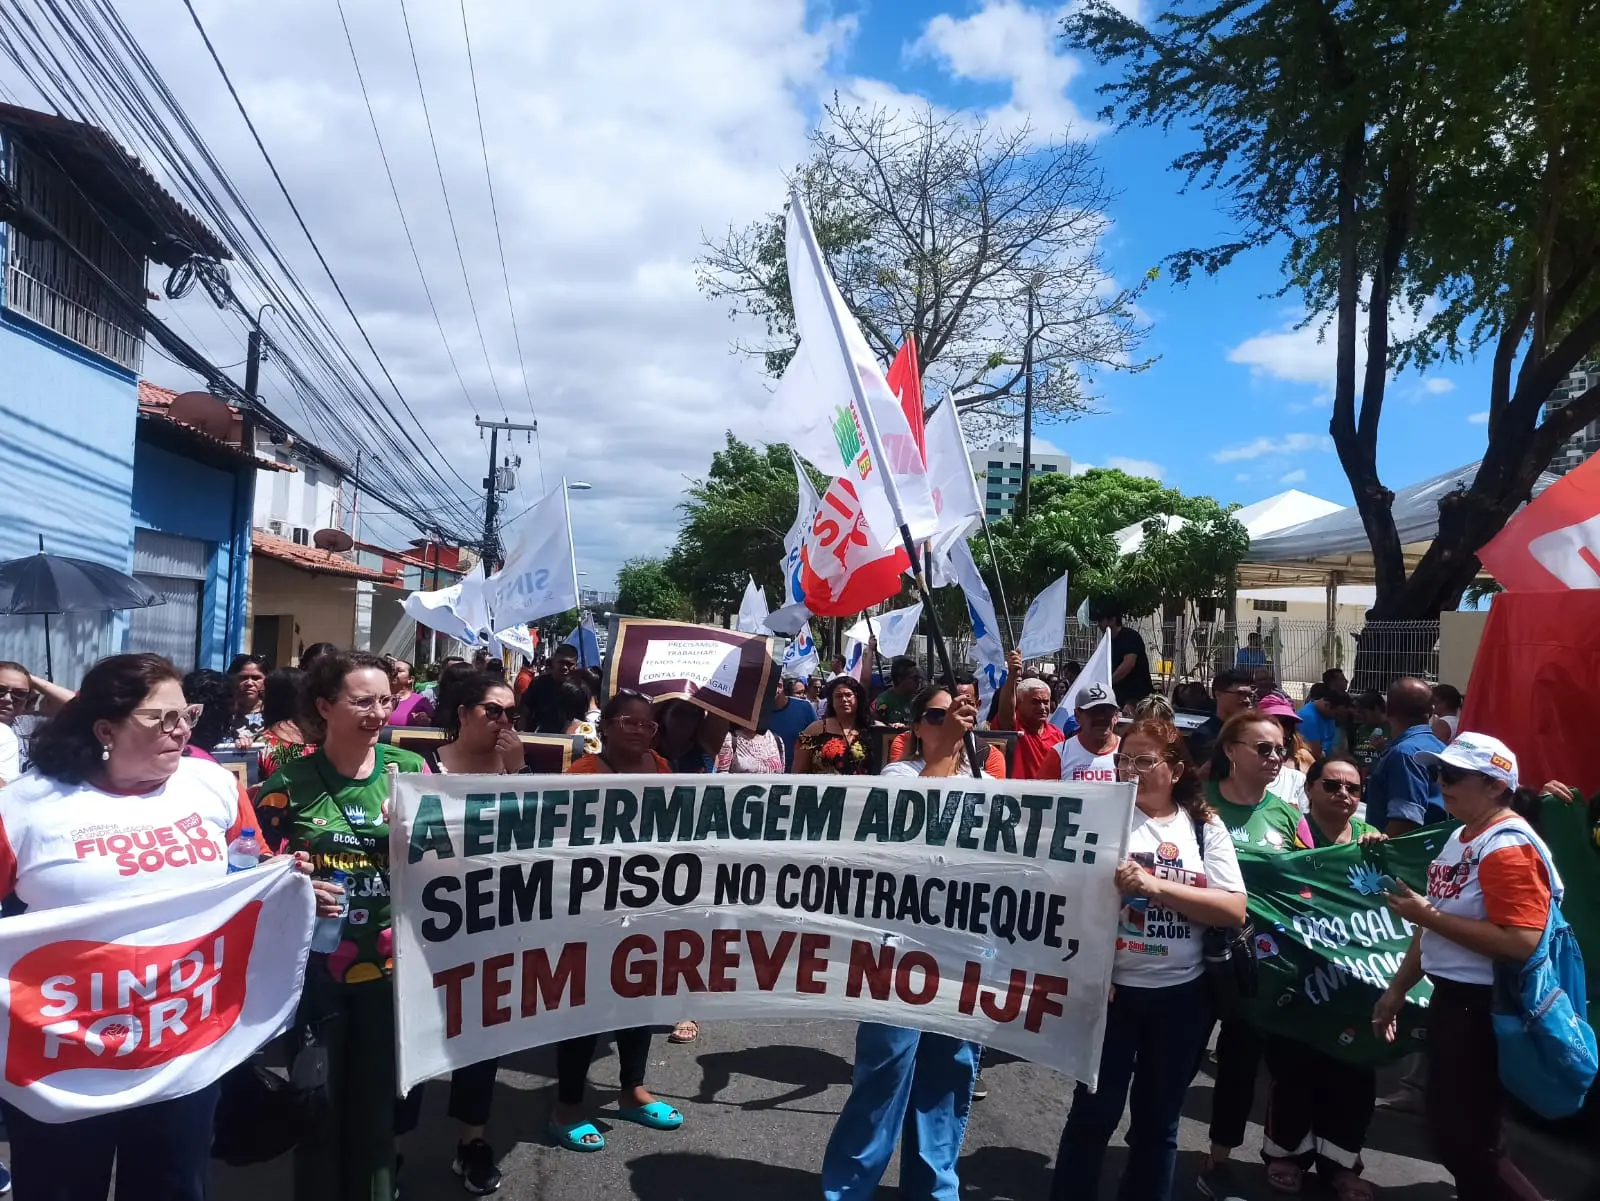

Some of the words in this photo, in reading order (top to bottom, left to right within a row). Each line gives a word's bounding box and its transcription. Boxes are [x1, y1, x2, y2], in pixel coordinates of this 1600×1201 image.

[643, 671, 677, 681] CONTAS
[680, 671, 701, 682] PARA
[702, 676, 732, 692] PAGAR!
[70, 823, 119, 837] CAMPANHA
[74, 826, 179, 859] FIQUE
[408, 793, 454, 865] A
[463, 785, 847, 858] ENFERMAGEM
[854, 786, 1099, 865] ADVERTE:
[420, 860, 554, 943] SEM
[568, 852, 703, 916] PISO
[713, 863, 767, 906] NO
[776, 863, 1080, 963] CONTRACHEQUE,
[1146, 922, 1191, 939] SAÚDE
[1147, 907, 1173, 922] NÃO
[39, 935, 225, 1018] SINDI
[432, 941, 588, 1040] TEM
[609, 928, 832, 999] GREVE
[845, 939, 941, 1006] NO
[958, 959, 1070, 1035] IJF
[41, 973, 222, 1060] FORT
